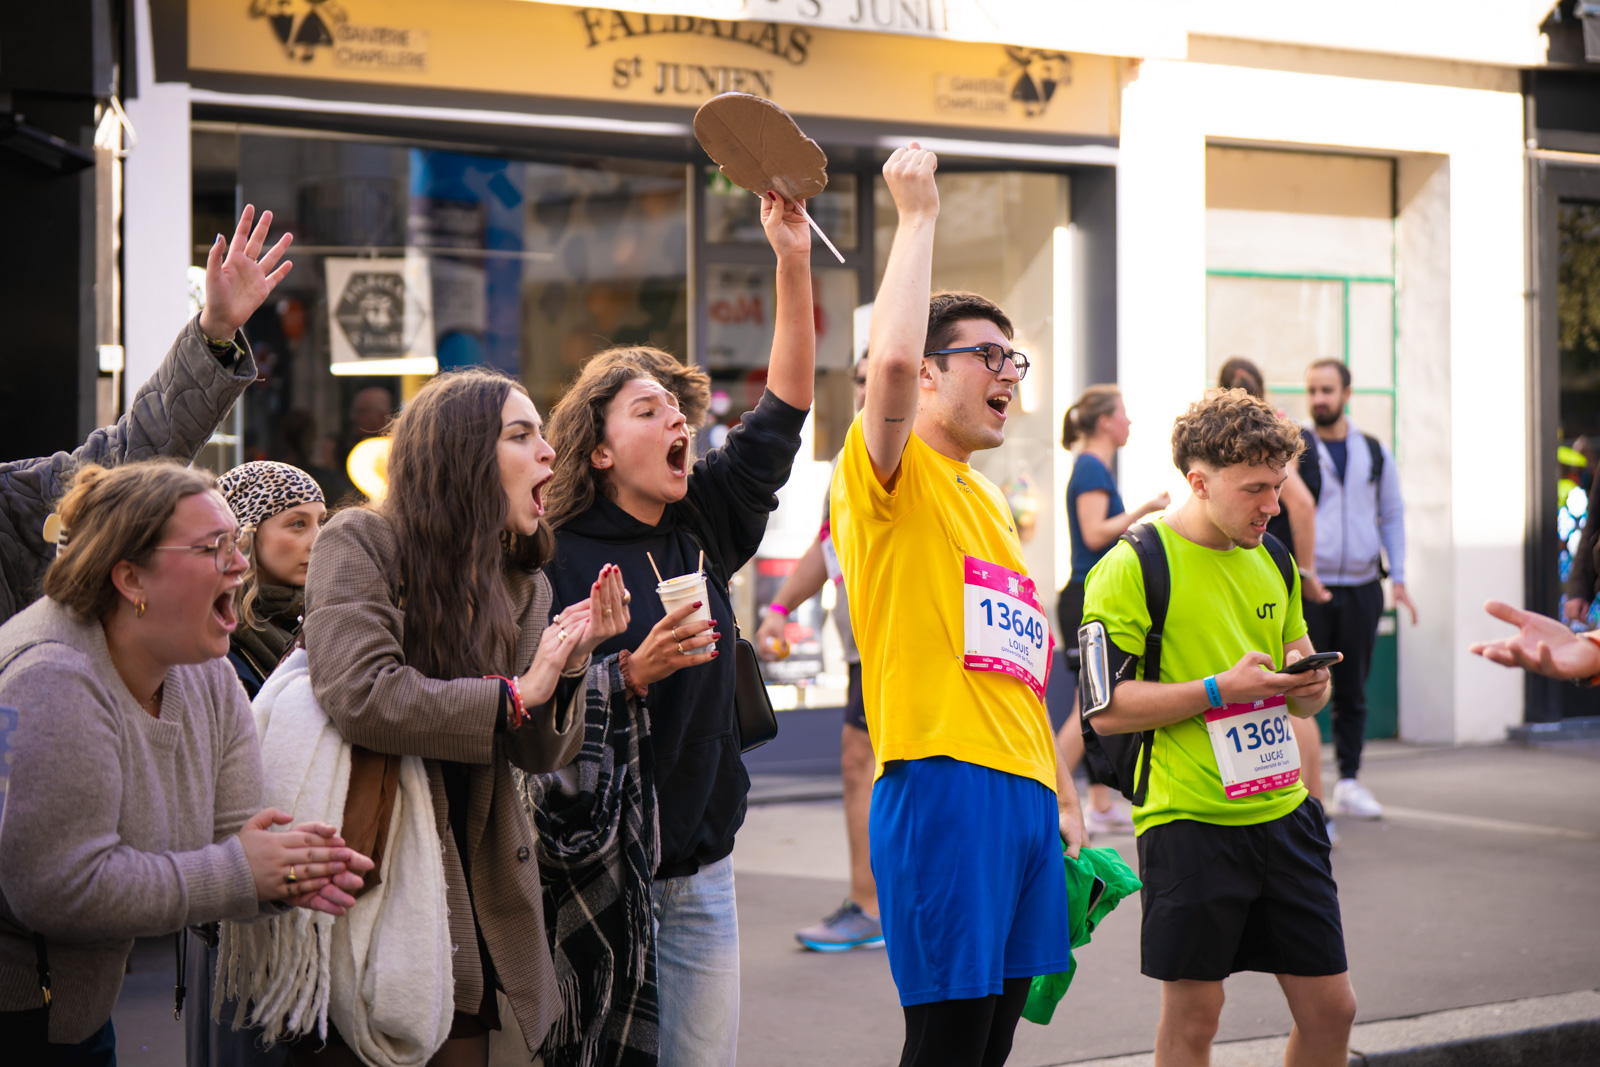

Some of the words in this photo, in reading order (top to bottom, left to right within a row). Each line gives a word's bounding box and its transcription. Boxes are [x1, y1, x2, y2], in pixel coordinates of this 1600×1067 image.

[654, 62, 772, 96] JUNIEN
[980, 598, 1043, 649] 13649
[1009, 637, 1029, 656] LOUIS
[1226, 714, 1292, 753] 13692
[1260, 749, 1284, 763] LUCAS
